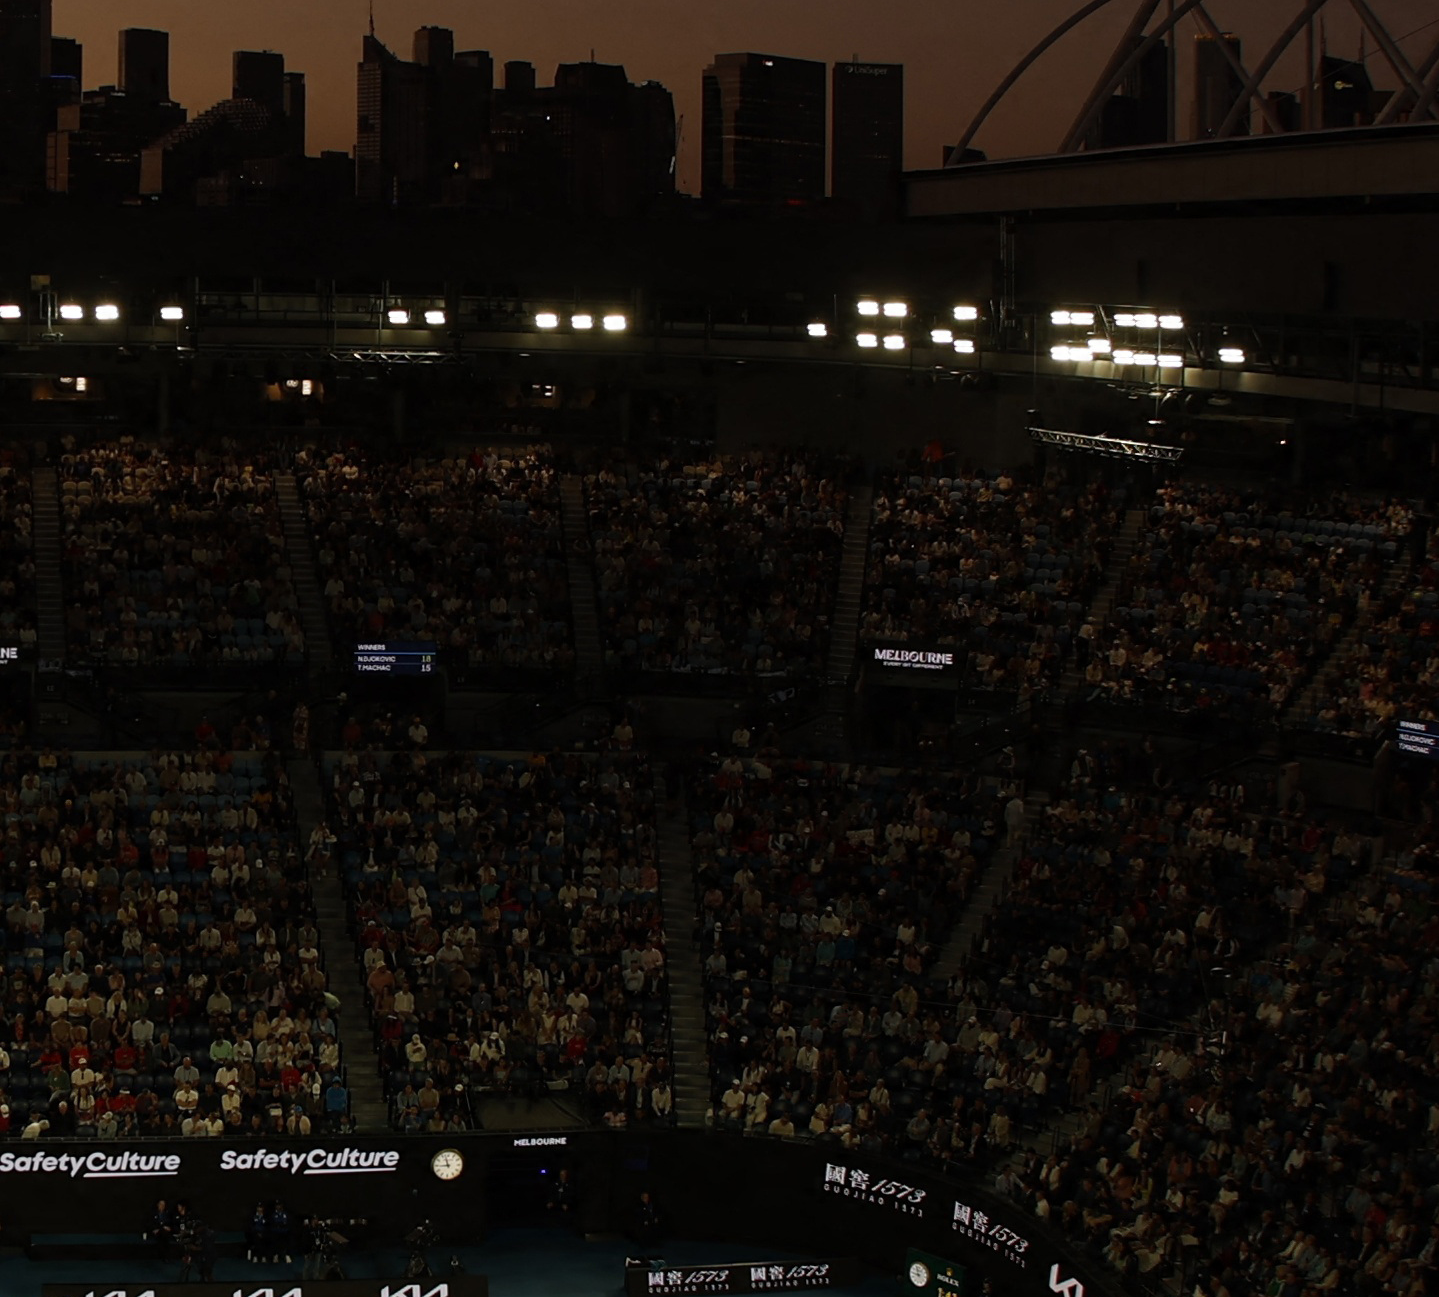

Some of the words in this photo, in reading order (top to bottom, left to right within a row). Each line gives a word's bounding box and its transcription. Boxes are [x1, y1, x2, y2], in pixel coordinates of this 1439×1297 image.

[421, 655, 431, 663] 18
[875, 649, 953, 664] MELBOURNE
[421, 664, 431, 672] 15
[513, 1137, 568, 1147] MELBOURNE
[220, 1148, 400, 1174] SafetyCulture
[936, 1273, 959, 1287] ROLEX
